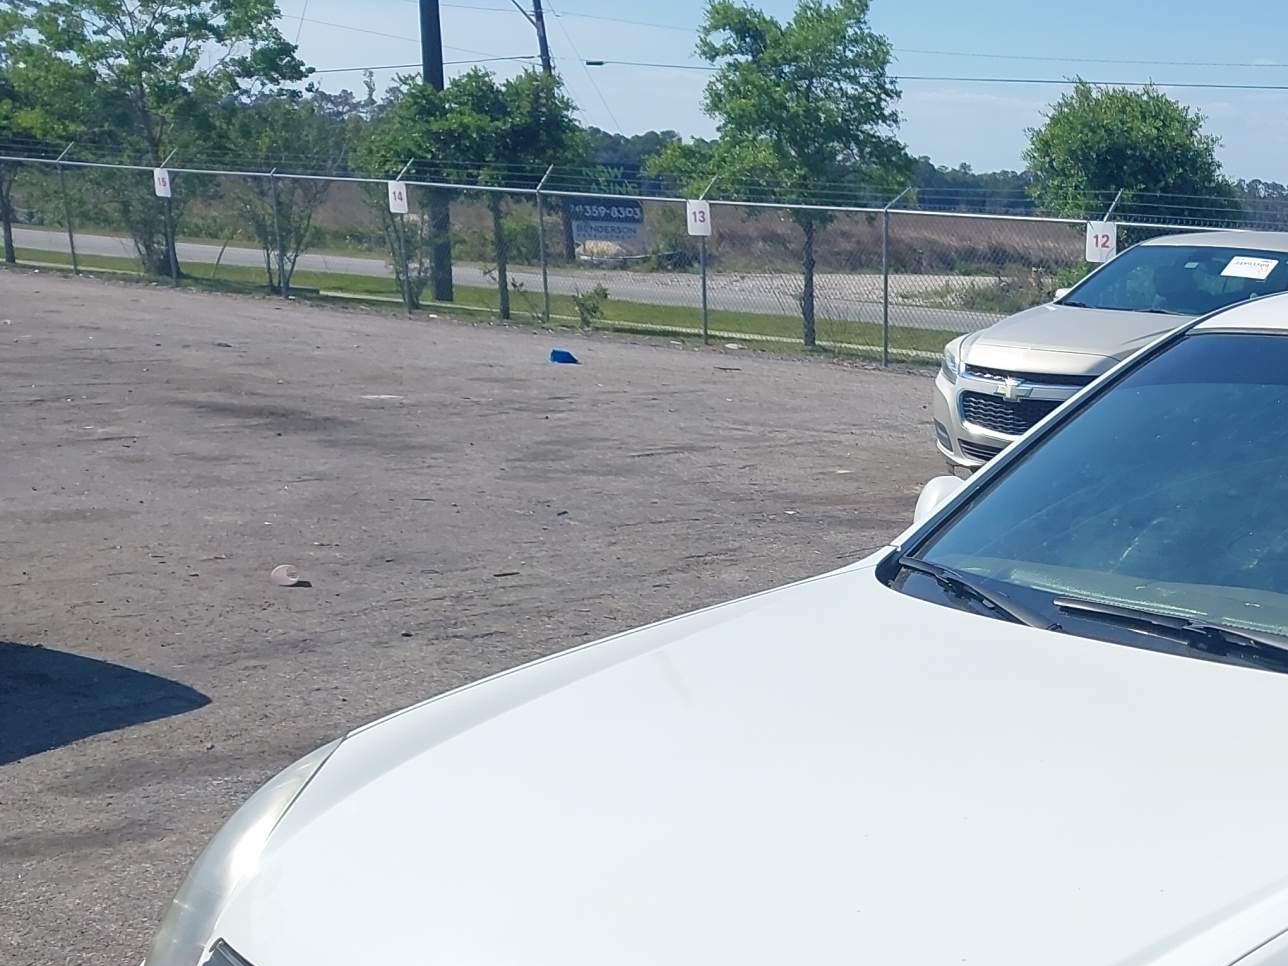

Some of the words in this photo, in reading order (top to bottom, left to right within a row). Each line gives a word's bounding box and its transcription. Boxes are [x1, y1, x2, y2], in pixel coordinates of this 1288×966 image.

[392, 190, 404, 202] 14
[691, 210, 706, 224] 13
[1093, 234, 1110, 249] 12
